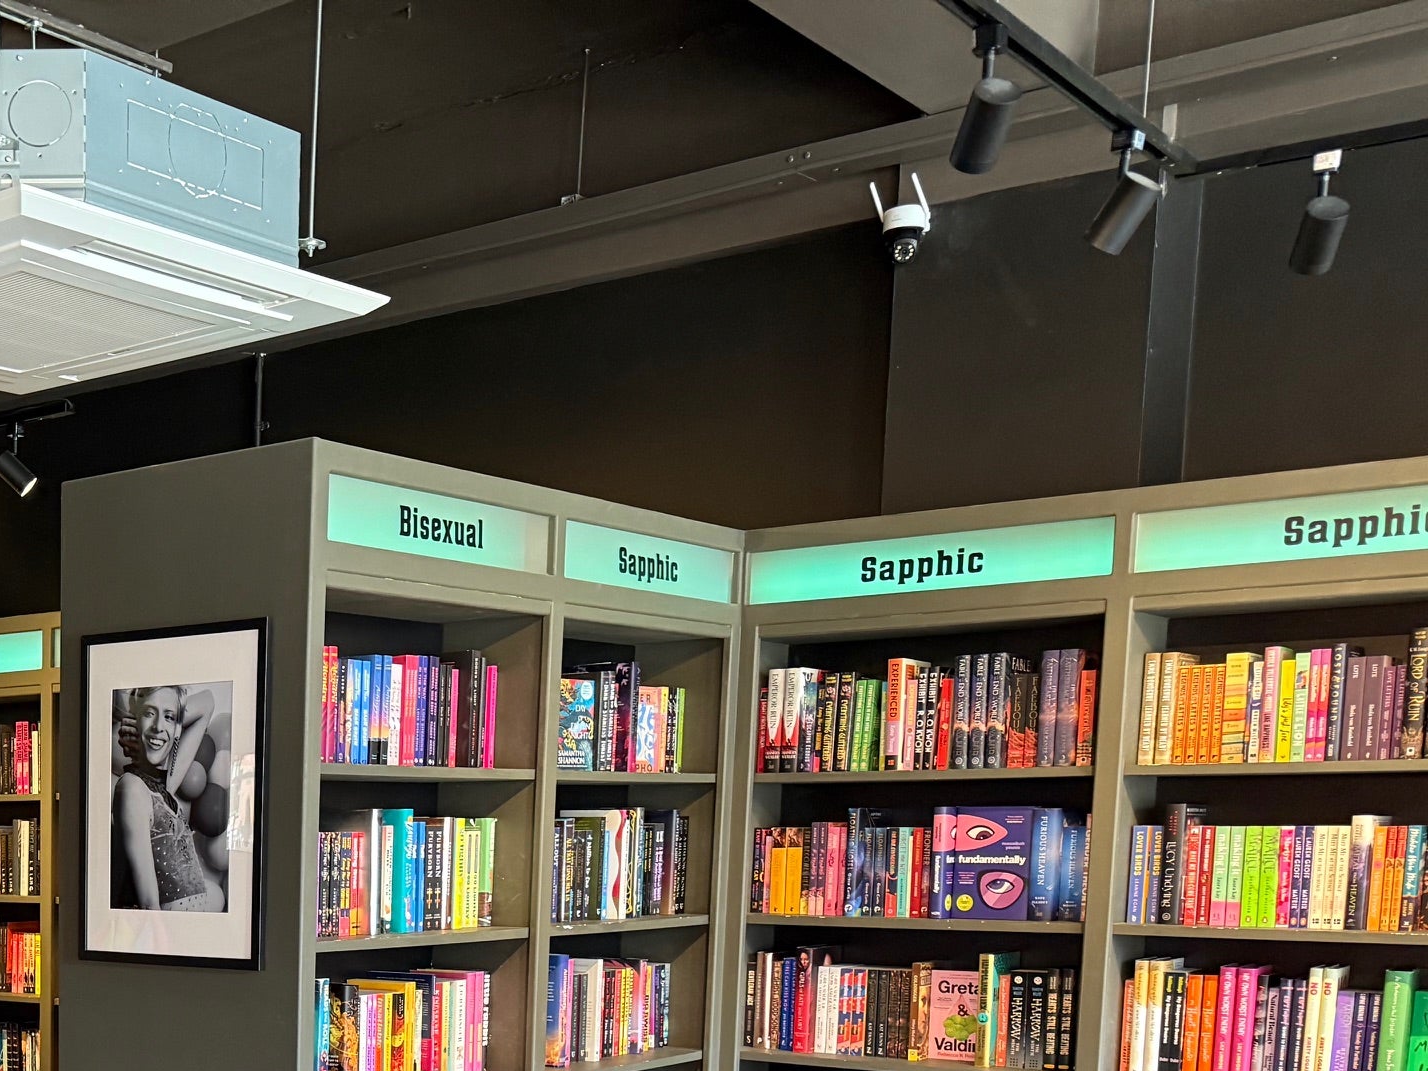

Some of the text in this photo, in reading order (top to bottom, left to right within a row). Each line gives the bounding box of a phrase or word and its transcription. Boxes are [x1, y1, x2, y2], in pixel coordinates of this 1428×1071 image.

[399, 505, 483, 549] Bisexual
[1284, 504, 1428, 548] Sapphi
[618, 546, 678, 583] Sapphic
[860, 547, 984, 584] Sapphic
[1412, 653, 1426, 679] LORD
[889, 662, 900, 718] EXPERIENCED
[1408, 691, 1425, 721] RUIN
[925, 672, 937, 753] EXHIBIT KWON
[915, 729, 923, 754] KWON
[923, 829, 931, 865] FRONTIER
[1039, 815, 1049, 850] FURIOUS
[959, 855, 1026, 866] fundamentally
[1037, 852, 1046, 886] HEAVEN
[1134, 855, 1142, 876] BIRDS
[1238, 972, 1250, 1036] MY OWN WORST ENEMY
[1311, 982, 1318, 995] NO
[1324, 982, 1332, 995] NO
[958, 1004, 969, 1016] &
[1011, 997, 1023, 1040] HARROW
[1030, 999, 1042, 1042] HARROW
[1046, 993, 1057, 1054] HEARTS STILL BEATING
[1060, 994, 1072, 1056] HEARTS STILL BEATING
